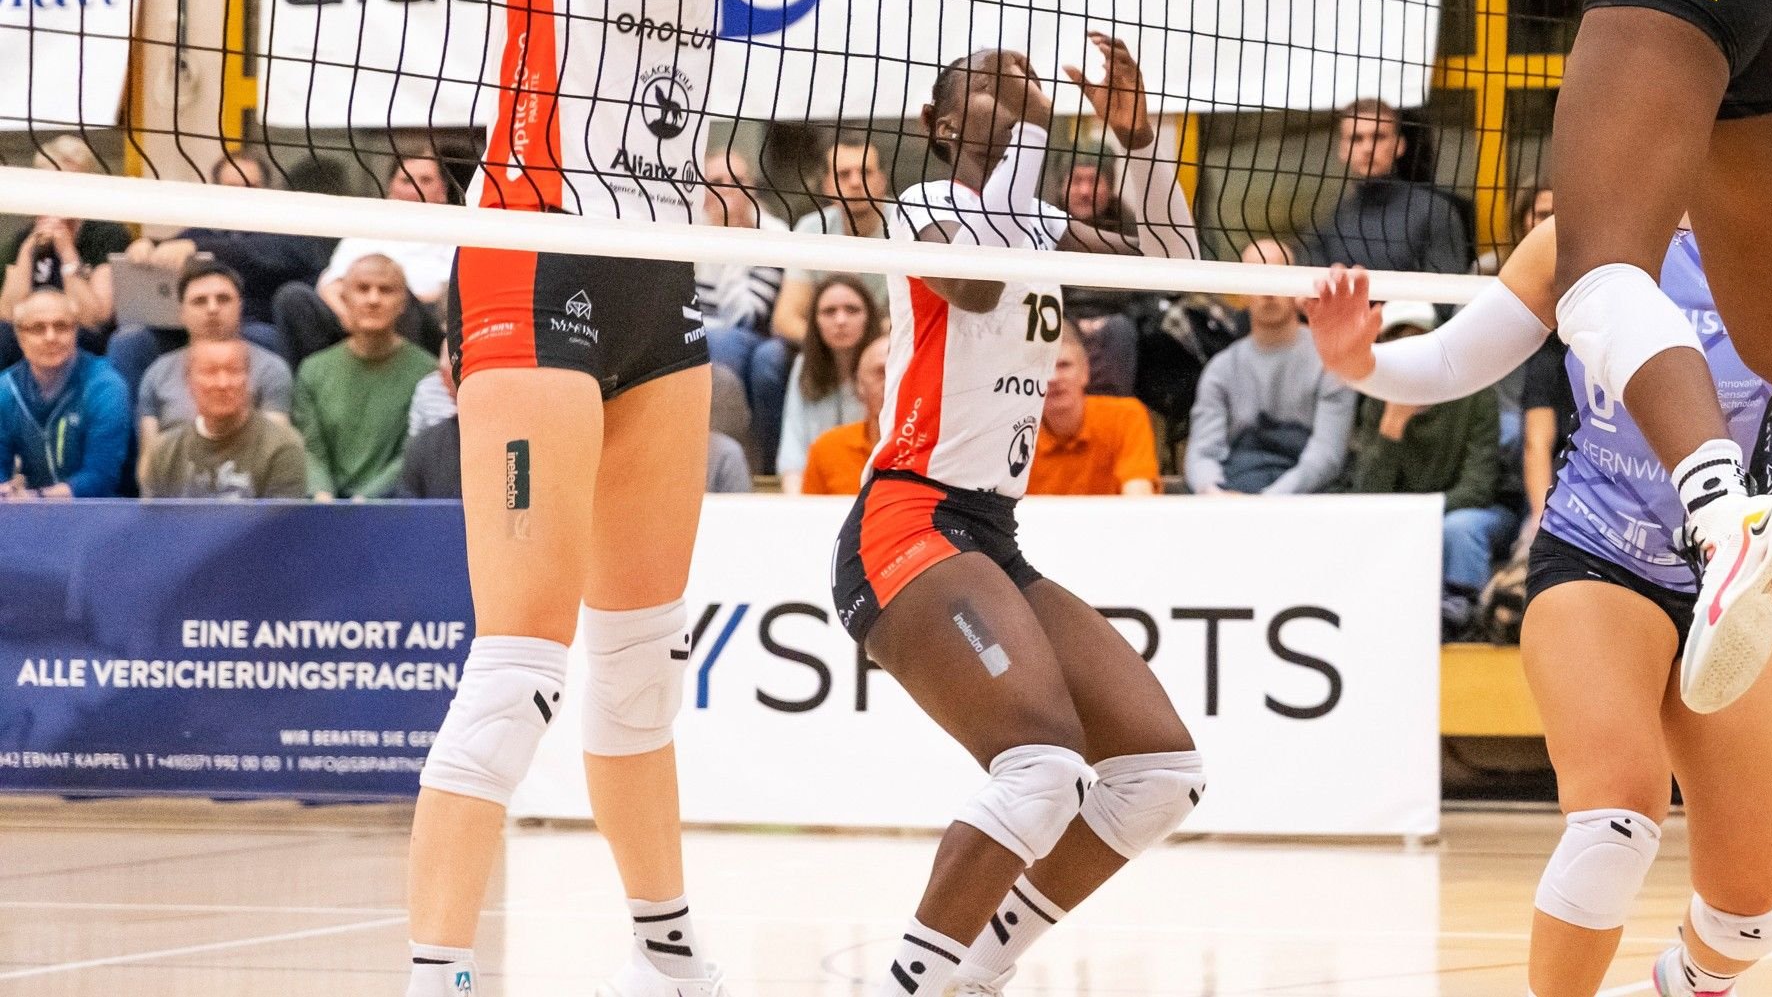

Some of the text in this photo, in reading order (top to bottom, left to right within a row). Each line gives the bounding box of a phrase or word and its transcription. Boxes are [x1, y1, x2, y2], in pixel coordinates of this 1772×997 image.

[1023, 292, 1062, 343] 10
[506, 450, 519, 510] inelectro
[182, 619, 465, 651] EINE ANTWORT AUF
[952, 611, 984, 654] inelectro
[17, 659, 463, 691] ALLE VERSICHERUNGSFRAGEN.
[280, 729, 438, 748] WIR BERATEN SIE GER
